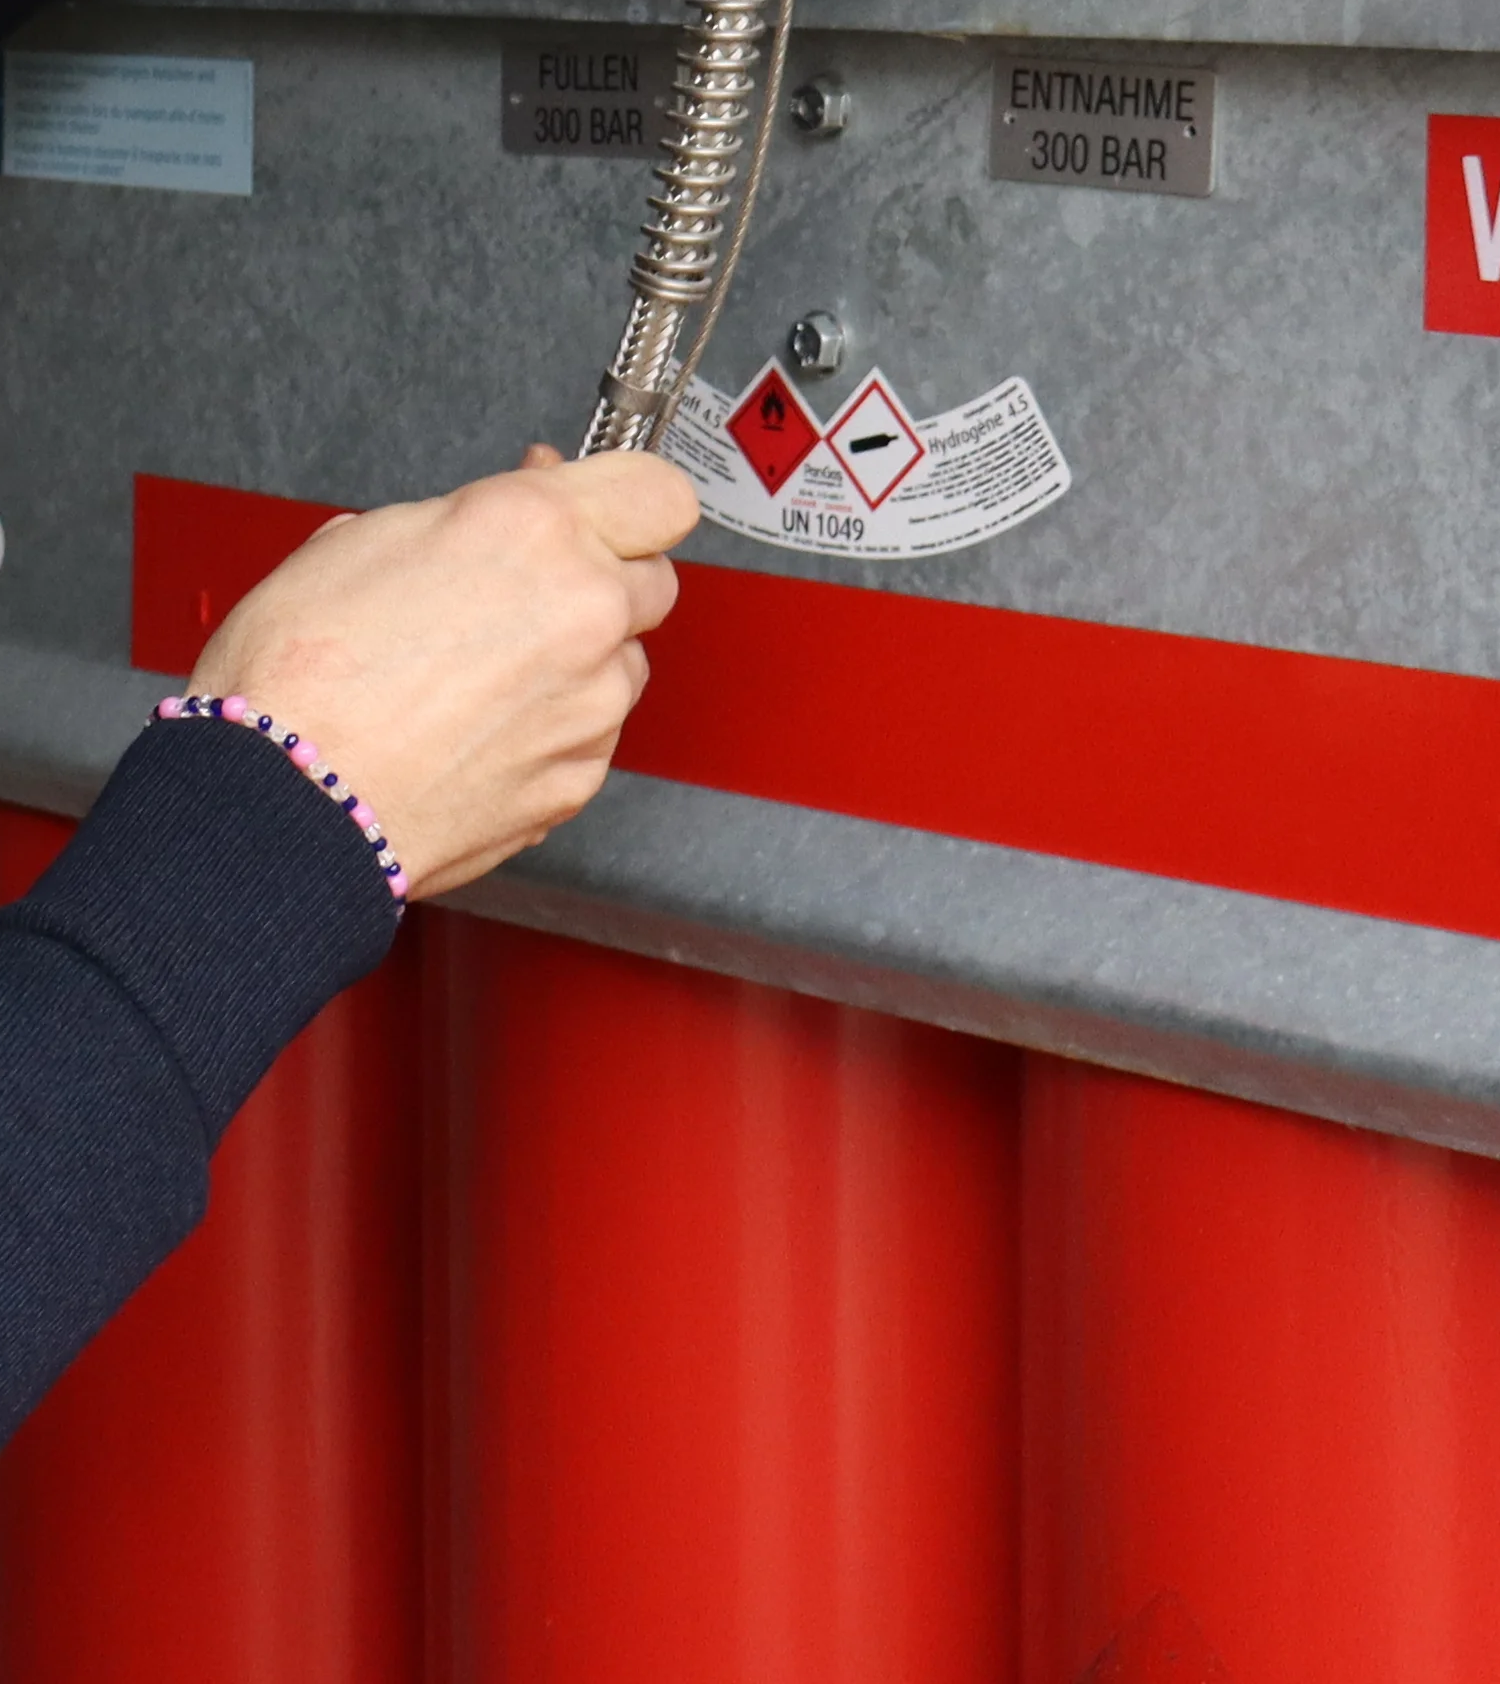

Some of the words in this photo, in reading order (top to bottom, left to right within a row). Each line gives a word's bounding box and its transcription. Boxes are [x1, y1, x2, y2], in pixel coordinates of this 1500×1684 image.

[1009, 67, 1196, 123] ENTNAHME
[534, 106, 582, 144] 300
[589, 107, 644, 146] BAR
[1030, 131, 1089, 175] 300
[1099, 135, 1168, 180] BAR
[701, 408, 723, 429] 4.5
[928, 412, 1005, 456] Hydrogène
[1006, 394, 1030, 417] 4.5
[781, 507, 810, 535] UN
[815, 511, 865, 541] 1049
